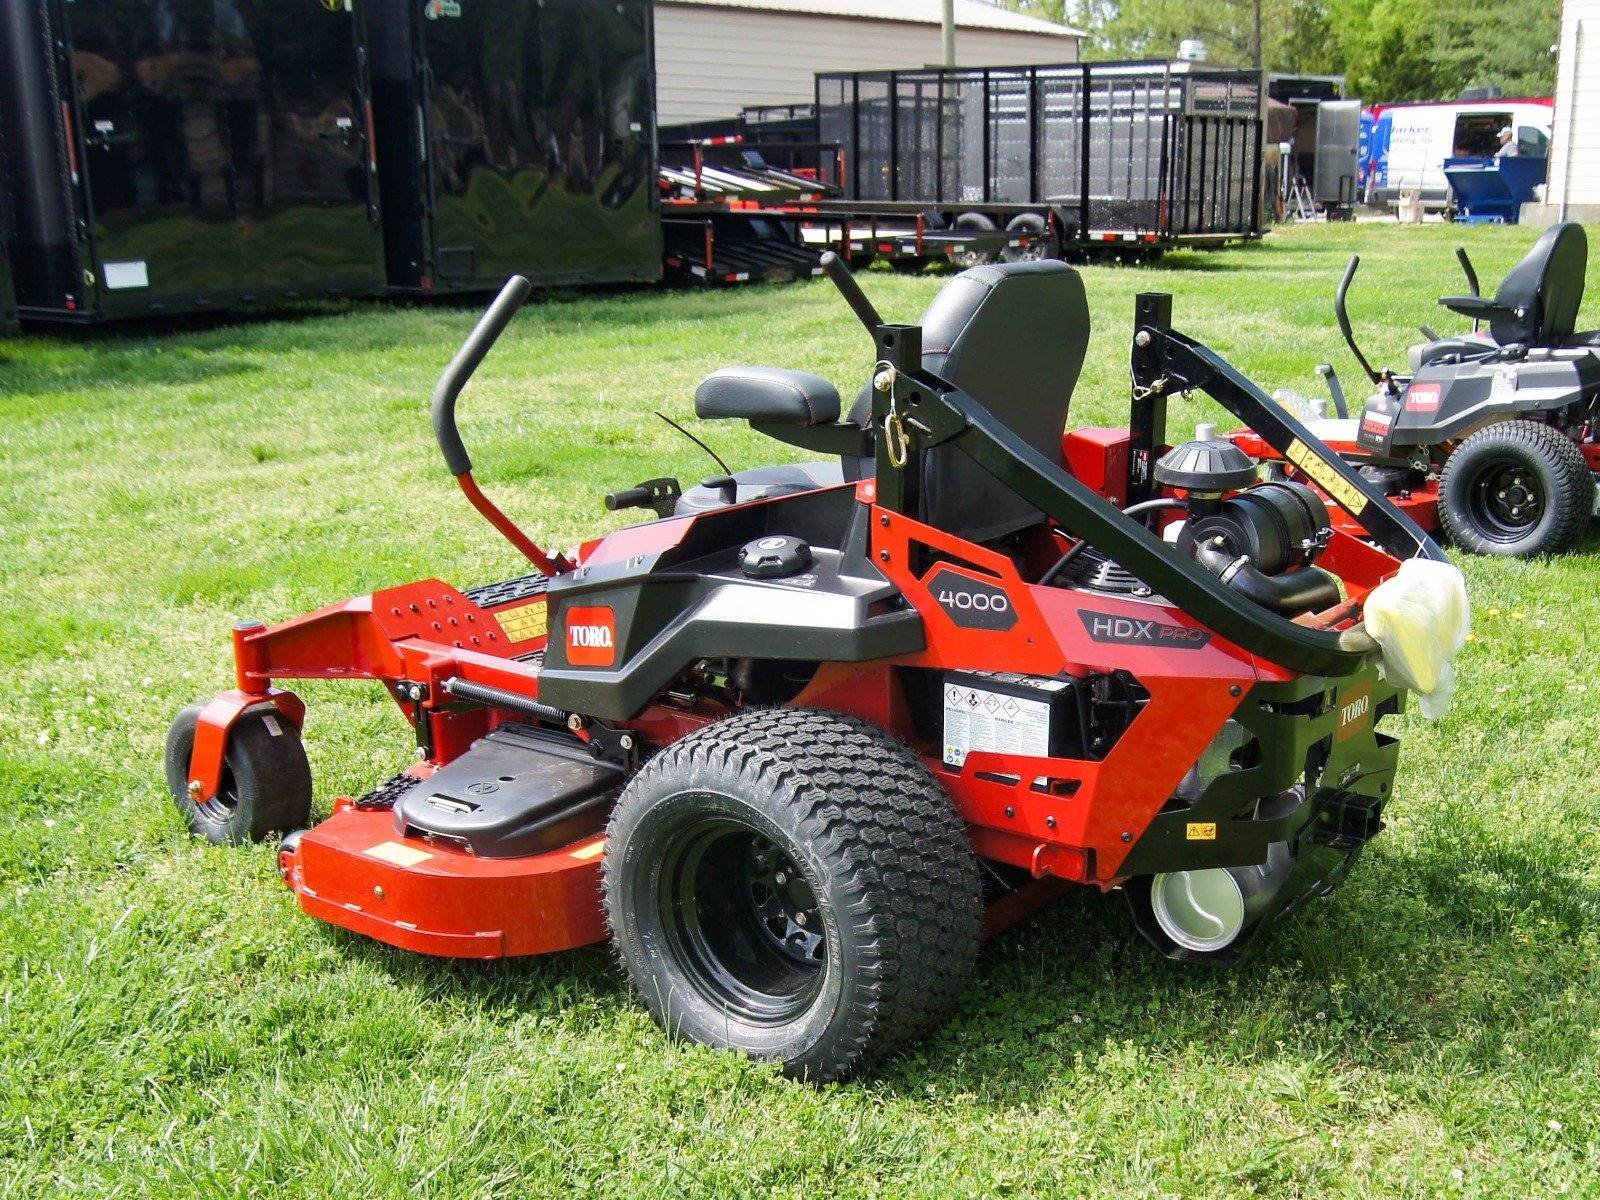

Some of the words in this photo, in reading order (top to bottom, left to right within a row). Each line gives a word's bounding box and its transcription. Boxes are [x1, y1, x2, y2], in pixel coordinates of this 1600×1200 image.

[938, 589, 1008, 613] 4000
[1092, 617, 1155, 639] HDX
[1158, 627, 1206, 643] PRO
[1341, 695, 1369, 727] TORO
